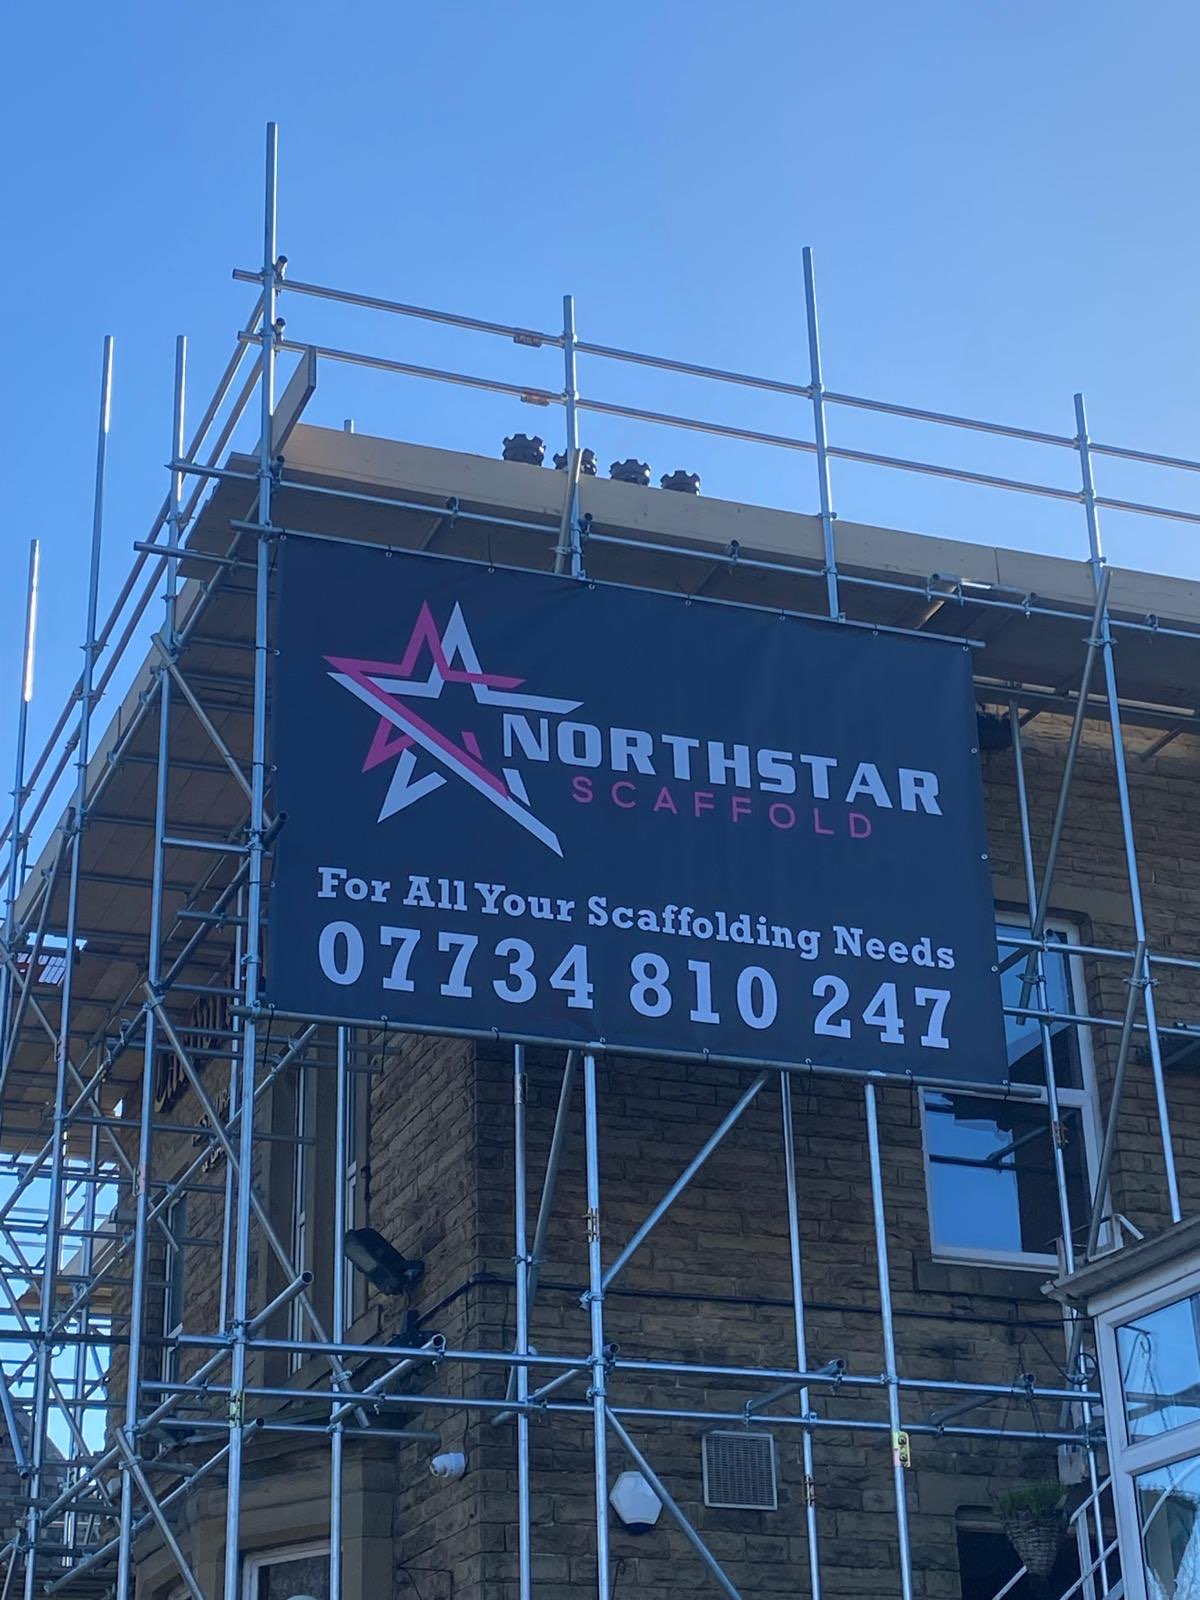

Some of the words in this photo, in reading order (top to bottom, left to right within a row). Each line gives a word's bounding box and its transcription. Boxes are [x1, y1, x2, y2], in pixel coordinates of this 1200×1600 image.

[502, 713, 943, 816] NORTHSTAR
[571, 775, 872, 839] SCAFFOLD
[317, 866, 391, 903] For
[402, 875, 468, 911] All
[474, 882, 575, 922] Your
[587, 895, 820, 960] Scaffolding
[832, 925, 955, 969] Needs
[318, 921, 594, 1010] 07734
[629, 952, 778, 1029] 810
[812, 974, 951, 1049] 247
